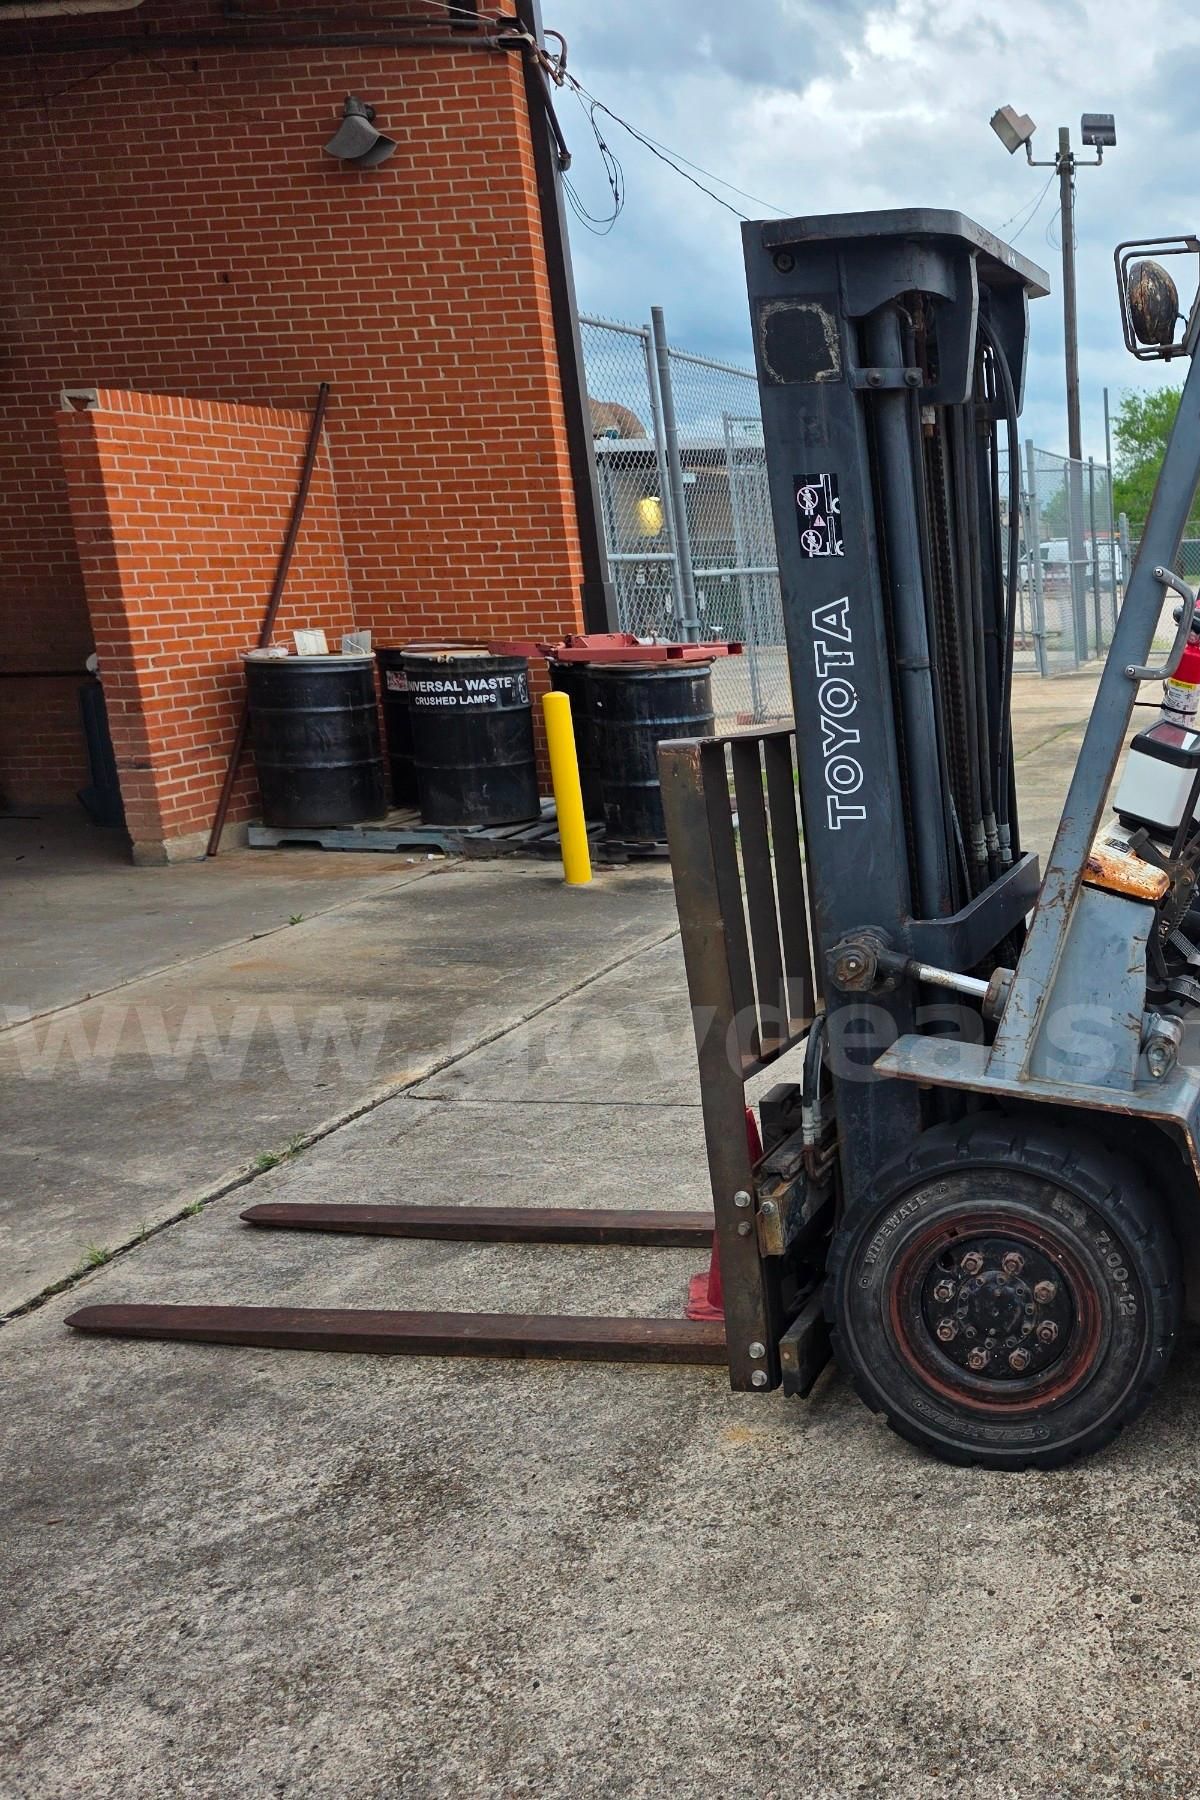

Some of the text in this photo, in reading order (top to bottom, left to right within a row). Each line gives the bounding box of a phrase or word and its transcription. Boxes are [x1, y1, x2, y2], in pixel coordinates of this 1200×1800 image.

[415, 693, 497, 706] CRUSHED LAMPS
[465, 677, 513, 691] WASTE
[812, 596, 867, 830] TOYOTA
[865, 1195, 928, 1264] WIDEWALL
[1094, 1230, 1138, 1316] 7.00-12
